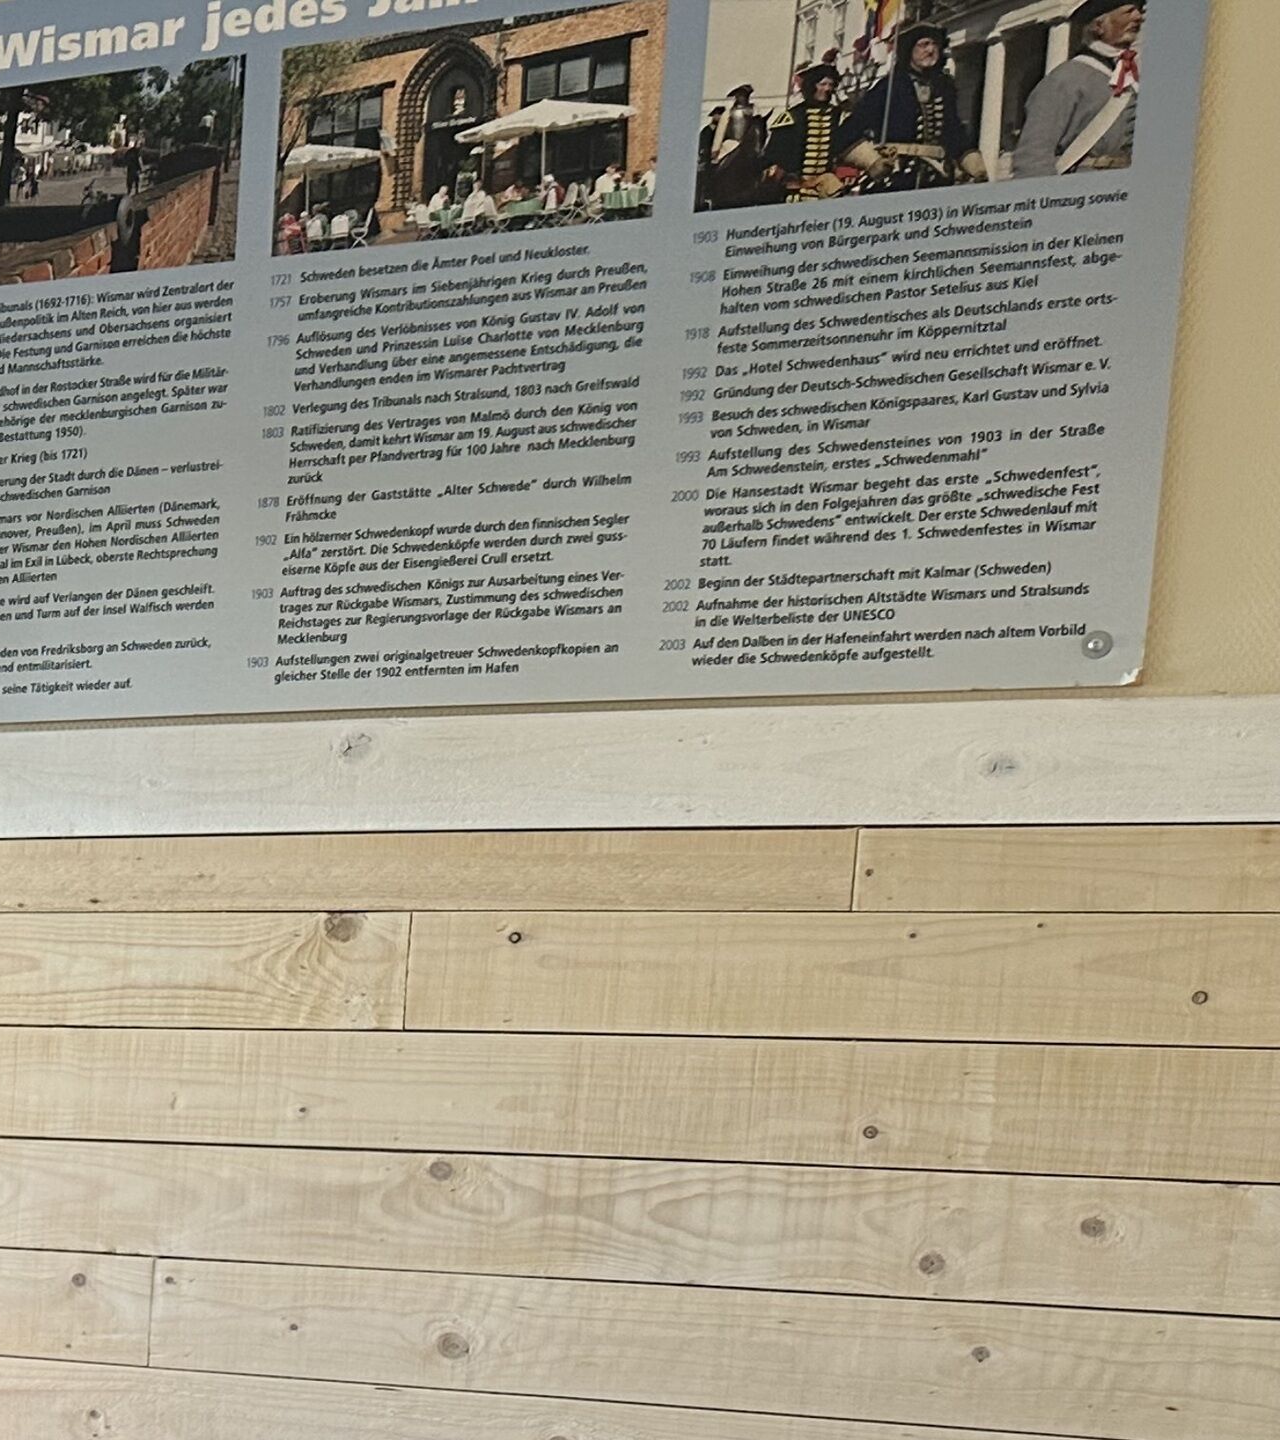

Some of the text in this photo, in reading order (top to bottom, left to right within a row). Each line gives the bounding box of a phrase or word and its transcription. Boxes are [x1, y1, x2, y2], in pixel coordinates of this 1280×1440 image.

[200, 0, 351, 55] jedes
[692, 229, 719, 245] 1903
[725, 219, 831, 241] Hundertjahrfeier
[857, 212, 905, 230] August
[907, 206, 944, 223] 1903)
[945, 205, 959, 220] in
[961, 202, 1012, 218] Wismar
[1012, 197, 1038, 213] mit
[1039, 195, 1086, 210] Umzug
[1087, 189, 1129, 206] sowie
[724, 216, 1034, 258] Einweihung von Bürgerpark und Schwedenstein
[270, 273, 293, 287] 1721
[299, 267, 356, 284] Schweden
[358, 263, 409, 278] besetzen
[410, 259, 430, 273] die
[470, 251, 497, 267] Poel
[498, 249, 522, 264] und
[682, 365, 709, 380] 1992
[714, 364, 739, 378] Das
[891, 348, 922, 363] wird
[924, 349, 950, 361] neu
[952, 342, 1012, 359] errichtet
[1013, 338, 1041, 354] und
[263, 375, 641, 418] 1802 Verlegung des Tribunals nach Stralsund, 1803 nach Greifswald
[679, 388, 707, 403] 1992
[713, 384, 776, 400] Gründung
[776, 381, 799, 395] der
[947, 362, 1029, 382] Gesellschaft
[1031, 361, 1084, 376] Wismar
[1098, 357, 1112, 370] V.
[286, 469, 324, 485] zurück
[705, 465, 729, 478] Am
[730, 459, 829, 477] Schwedenstein,
[831, 457, 872, 471] erstes
[257, 496, 280, 509] 1878
[286, 492, 343, 507] Eröffnung
[346, 490, 367, 503] der
[542, 476, 578, 490] durch
[581, 473, 633, 488] Wilhelm
[663, 577, 692, 592] 2002
[697, 576, 741, 592] Beginn
[743, 574, 766, 588] der
[897, 567, 921, 581] mit
[923, 565, 972, 579] Kalmar
[973, 560, 1052, 579] (Schweden)
[661, 581, 1090, 614] 2002 Aufnahme der historischen Altstädte Wismars und Stralsunds
[694, 615, 707, 628] in
[709, 614, 730, 628] die
[817, 610, 841, 624] der
[842, 608, 896, 623] UNESCO
[246, 656, 270, 669] 1903
[274, 653, 351, 667] Aufstellungen
[353, 651, 380, 664] zwei
[382, 648, 475, 665] originalgetreuer
[603, 643, 620, 654] an
[273, 660, 520, 685] gleicher Stelle der 1902 entfernten im Hafen
